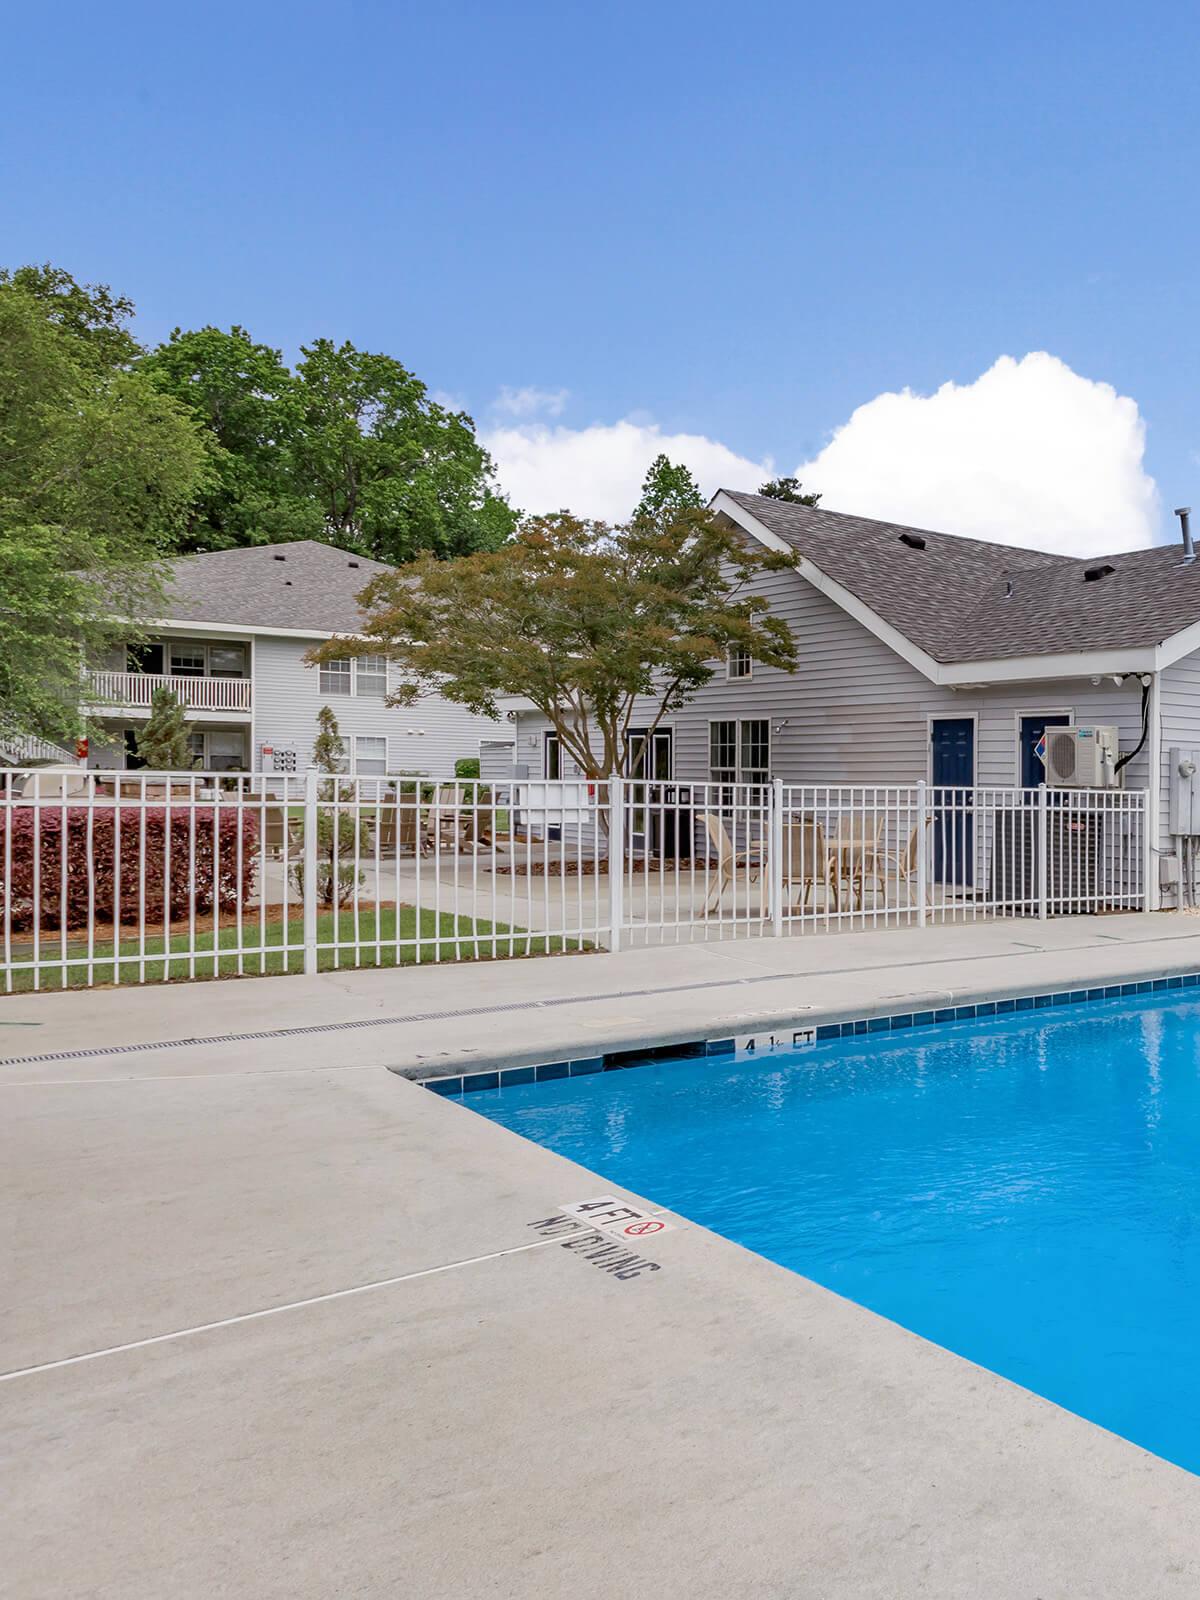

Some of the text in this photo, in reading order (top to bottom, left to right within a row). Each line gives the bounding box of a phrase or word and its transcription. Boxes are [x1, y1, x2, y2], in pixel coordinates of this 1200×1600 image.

[792, 1030, 815, 1047] FT
[575, 1201, 644, 1225] 4 FT
[560, 1234, 662, 1281] DIVING
